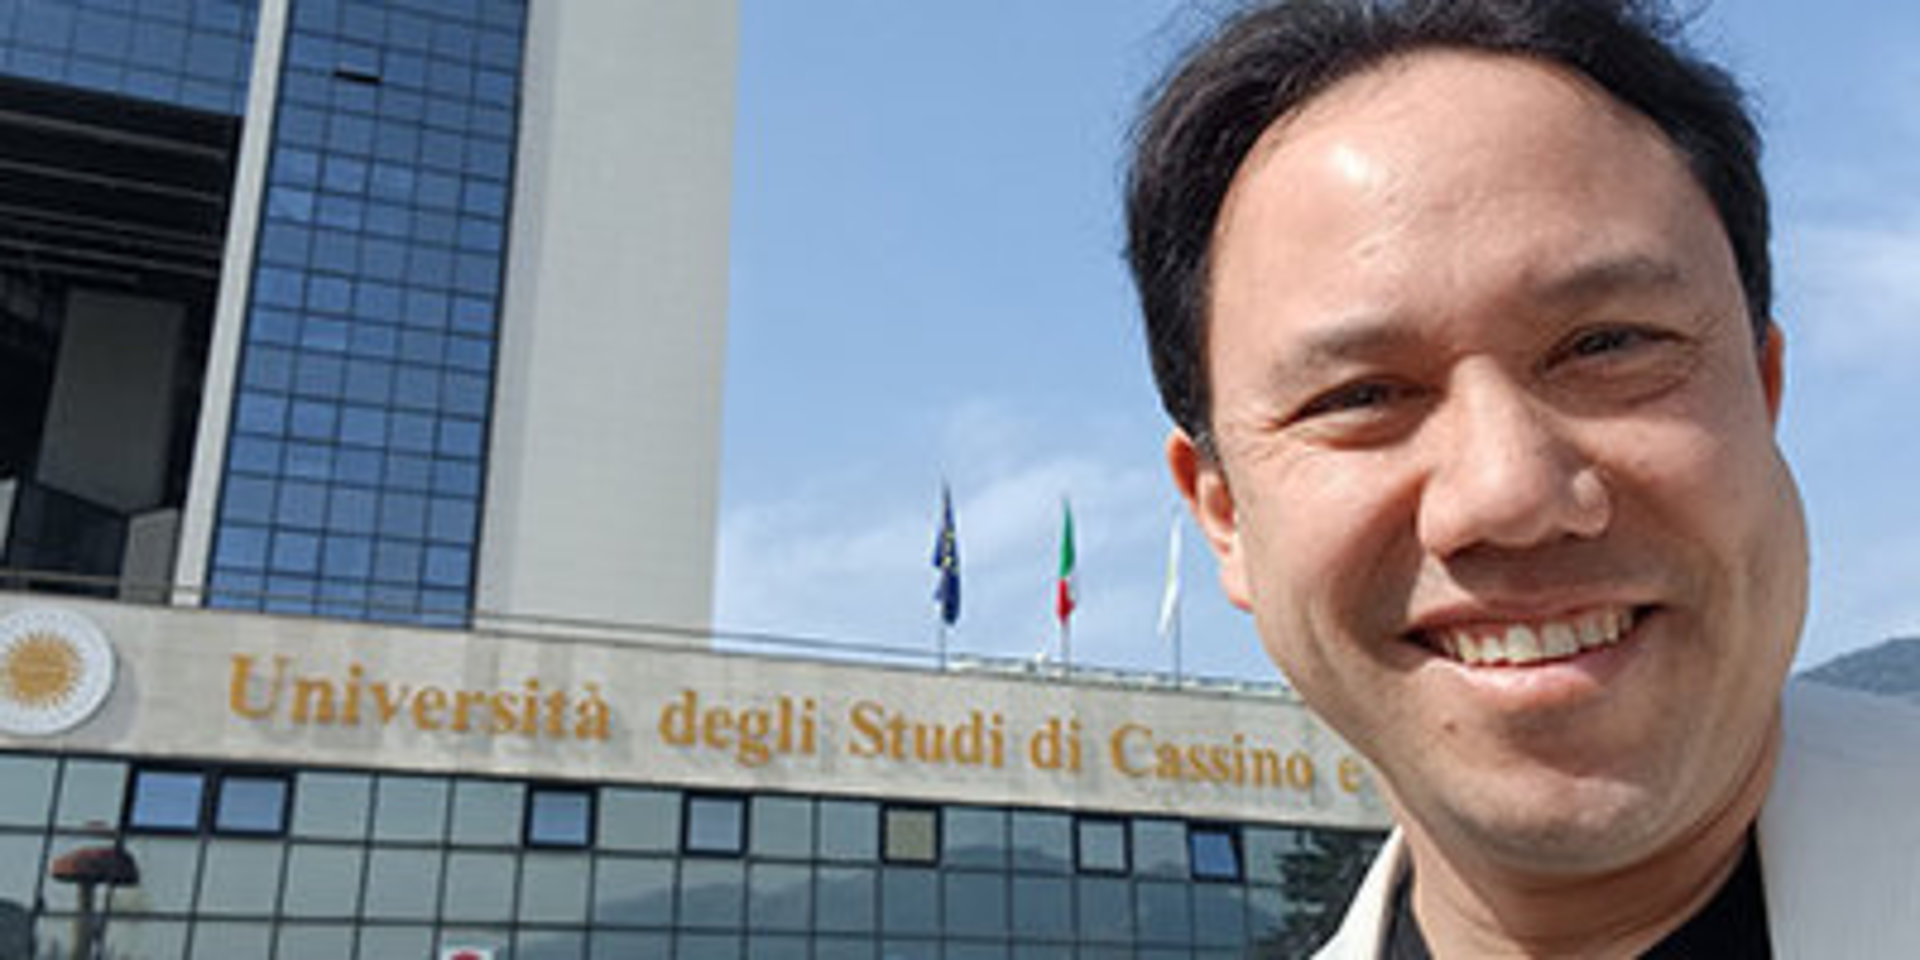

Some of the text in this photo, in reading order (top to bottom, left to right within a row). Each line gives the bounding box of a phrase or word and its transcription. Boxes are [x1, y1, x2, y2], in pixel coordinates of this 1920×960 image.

[229, 653, 1364, 793] Università degli Studi di Cassino e
